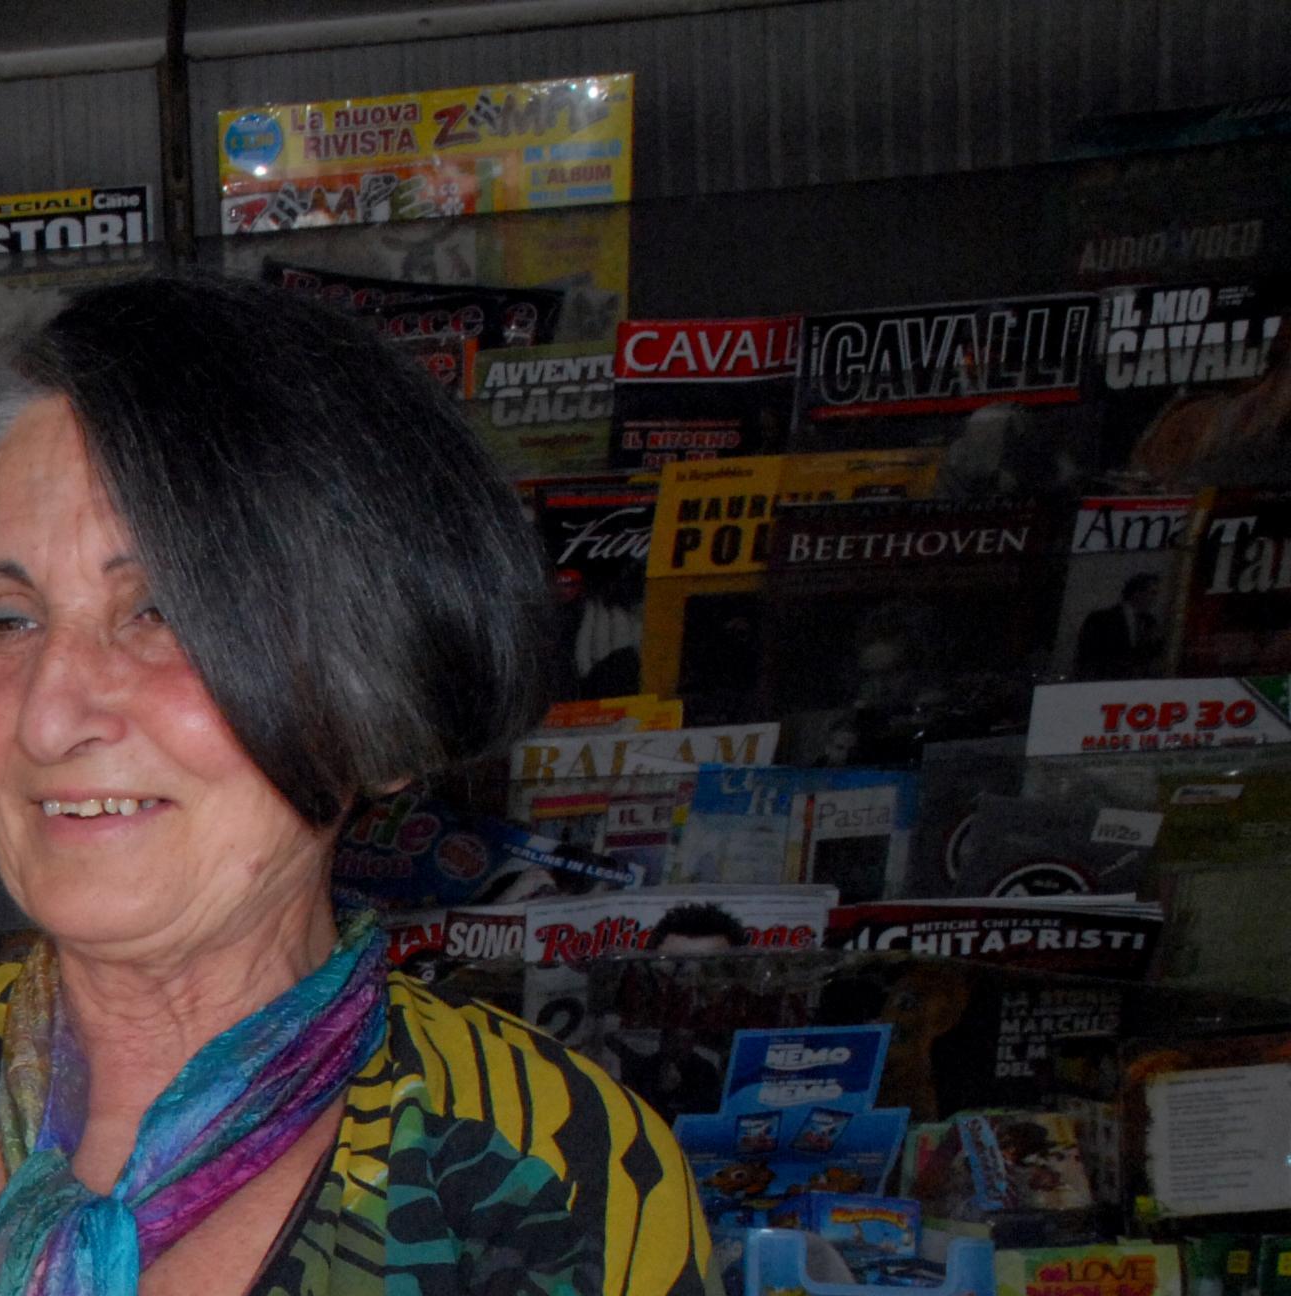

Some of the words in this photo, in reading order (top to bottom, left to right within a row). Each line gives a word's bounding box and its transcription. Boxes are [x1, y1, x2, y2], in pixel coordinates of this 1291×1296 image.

[292, 108, 324, 131] La
[334, 103, 418, 128] nuova
[305, 127, 416, 159] RIVISTA
[1109, 294, 1142, 330] IL
[1149, 287, 1212, 326] MIO
[818, 303, 1091, 406] CAVALLI
[787, 526, 1032, 564] BEETHOVEN
[1101, 701, 1188, 733] TOP
[1195, 699, 1257, 730] 30
[1081, 734, 1131, 750] MADE
[1138, 733, 1159, 749] IN
[521, 732, 763, 790] RAKAM
[819, 802, 892, 829] Pasta
